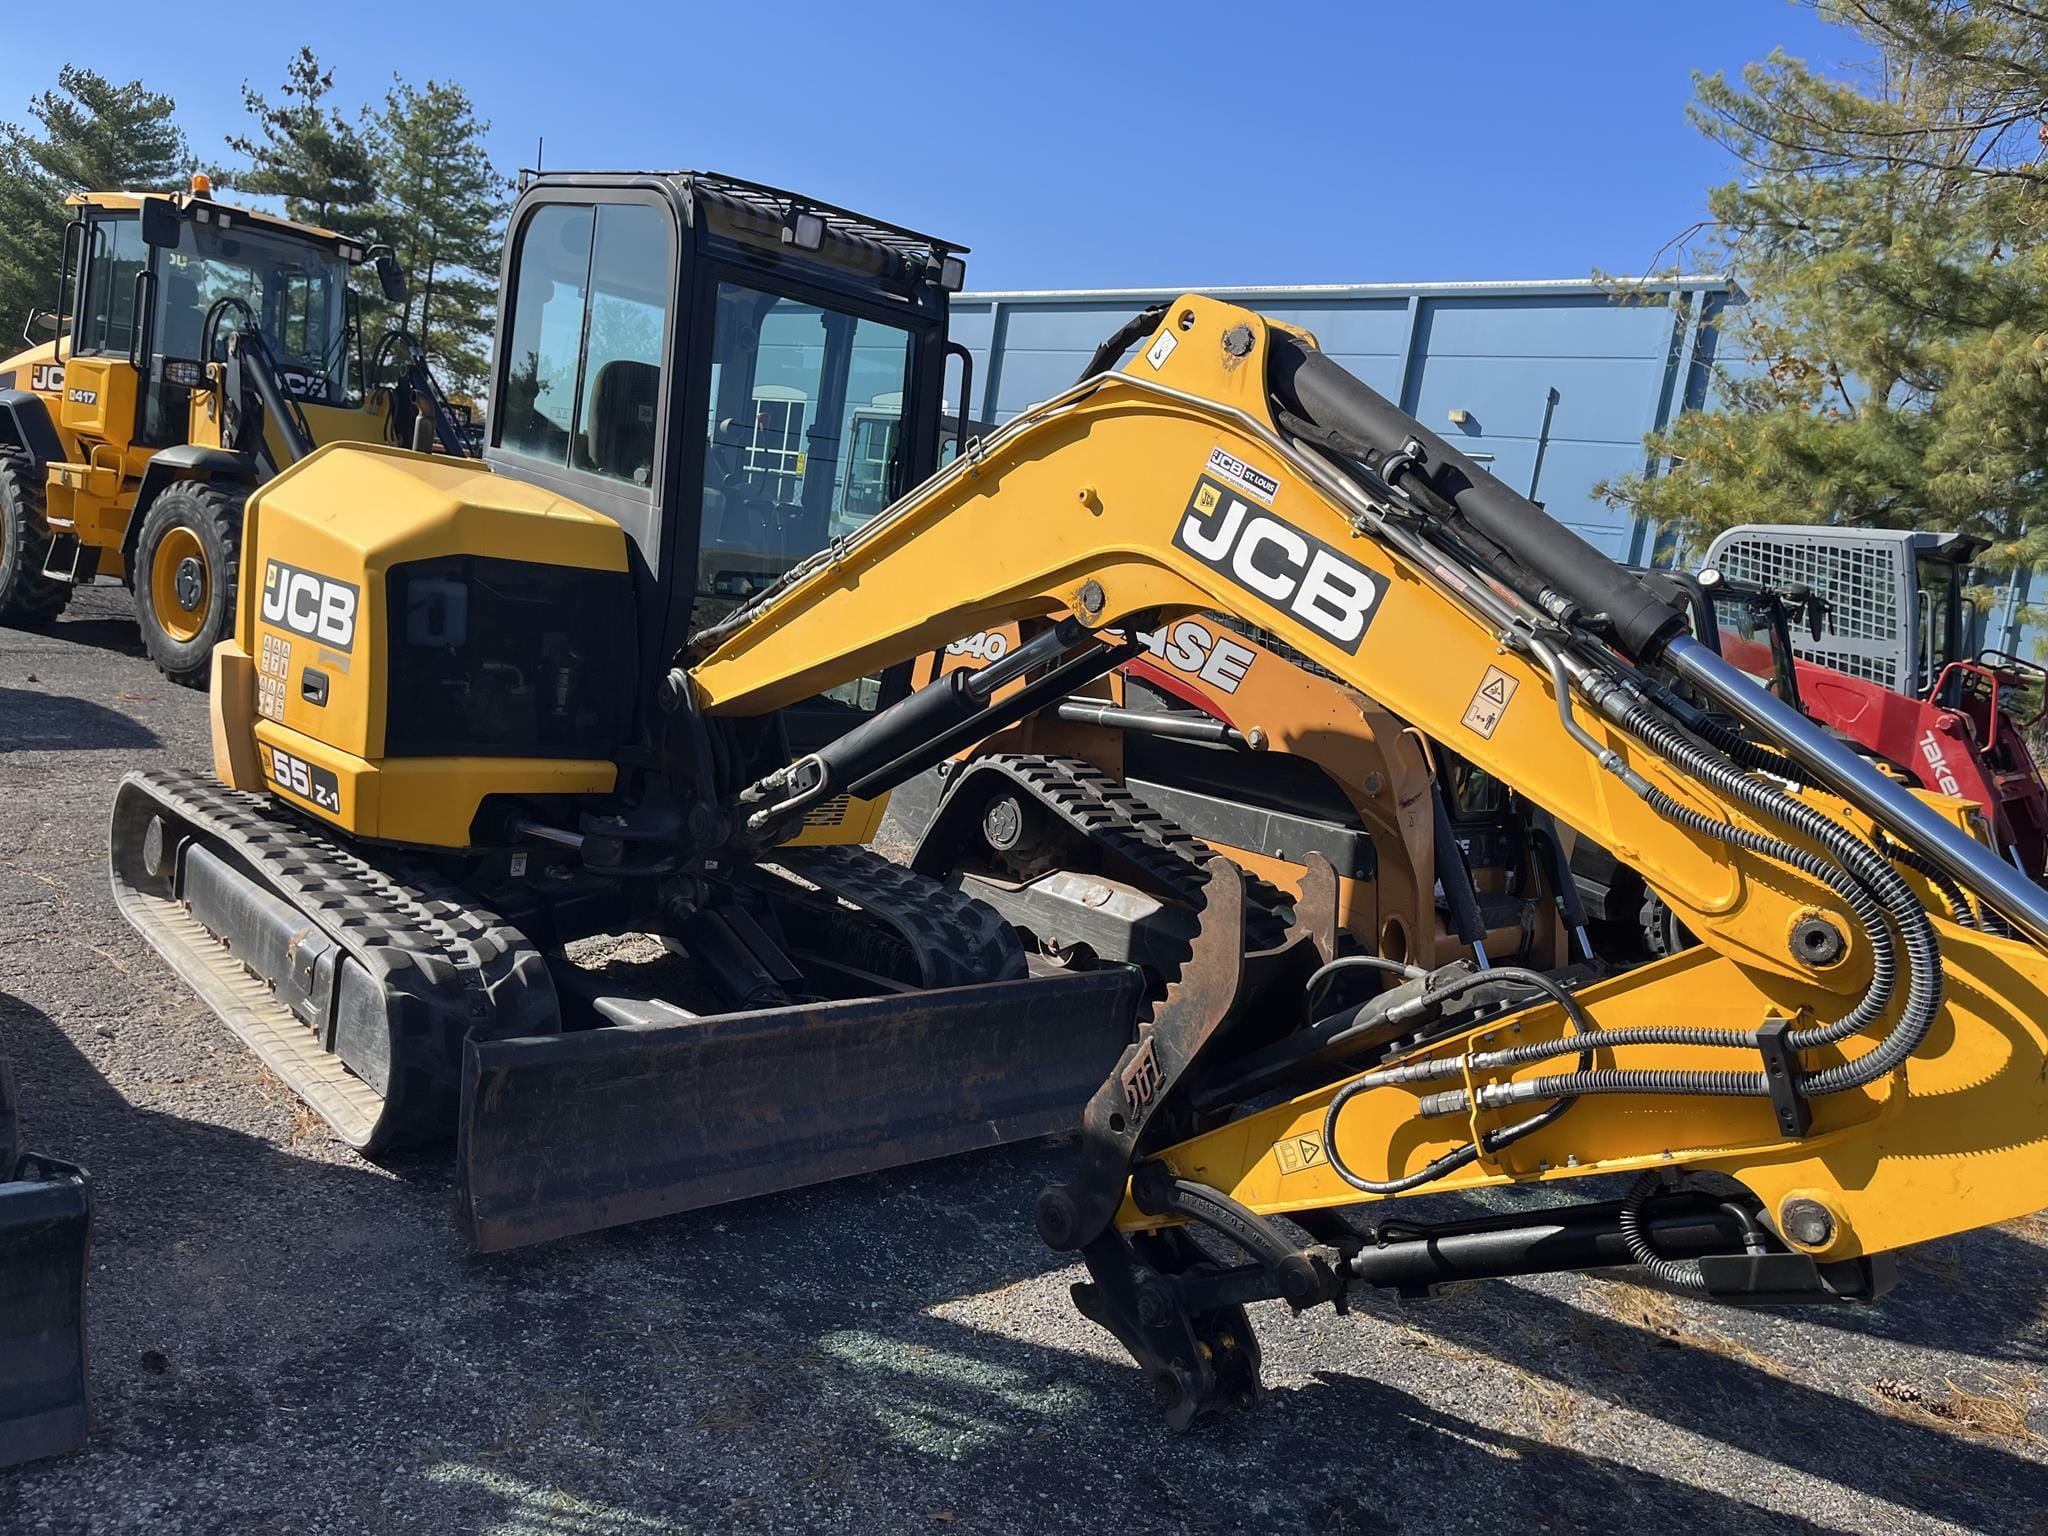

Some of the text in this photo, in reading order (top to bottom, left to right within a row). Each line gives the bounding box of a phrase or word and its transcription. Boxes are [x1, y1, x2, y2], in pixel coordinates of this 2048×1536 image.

[75, 390, 96, 405] 417
[1211, 452, 1243, 478] JCB
[1255, 476, 1275, 492] LOUIS
[1182, 499, 1376, 642] JCB
[263, 568, 355, 645] JCB
[273, 749, 309, 796] 55
